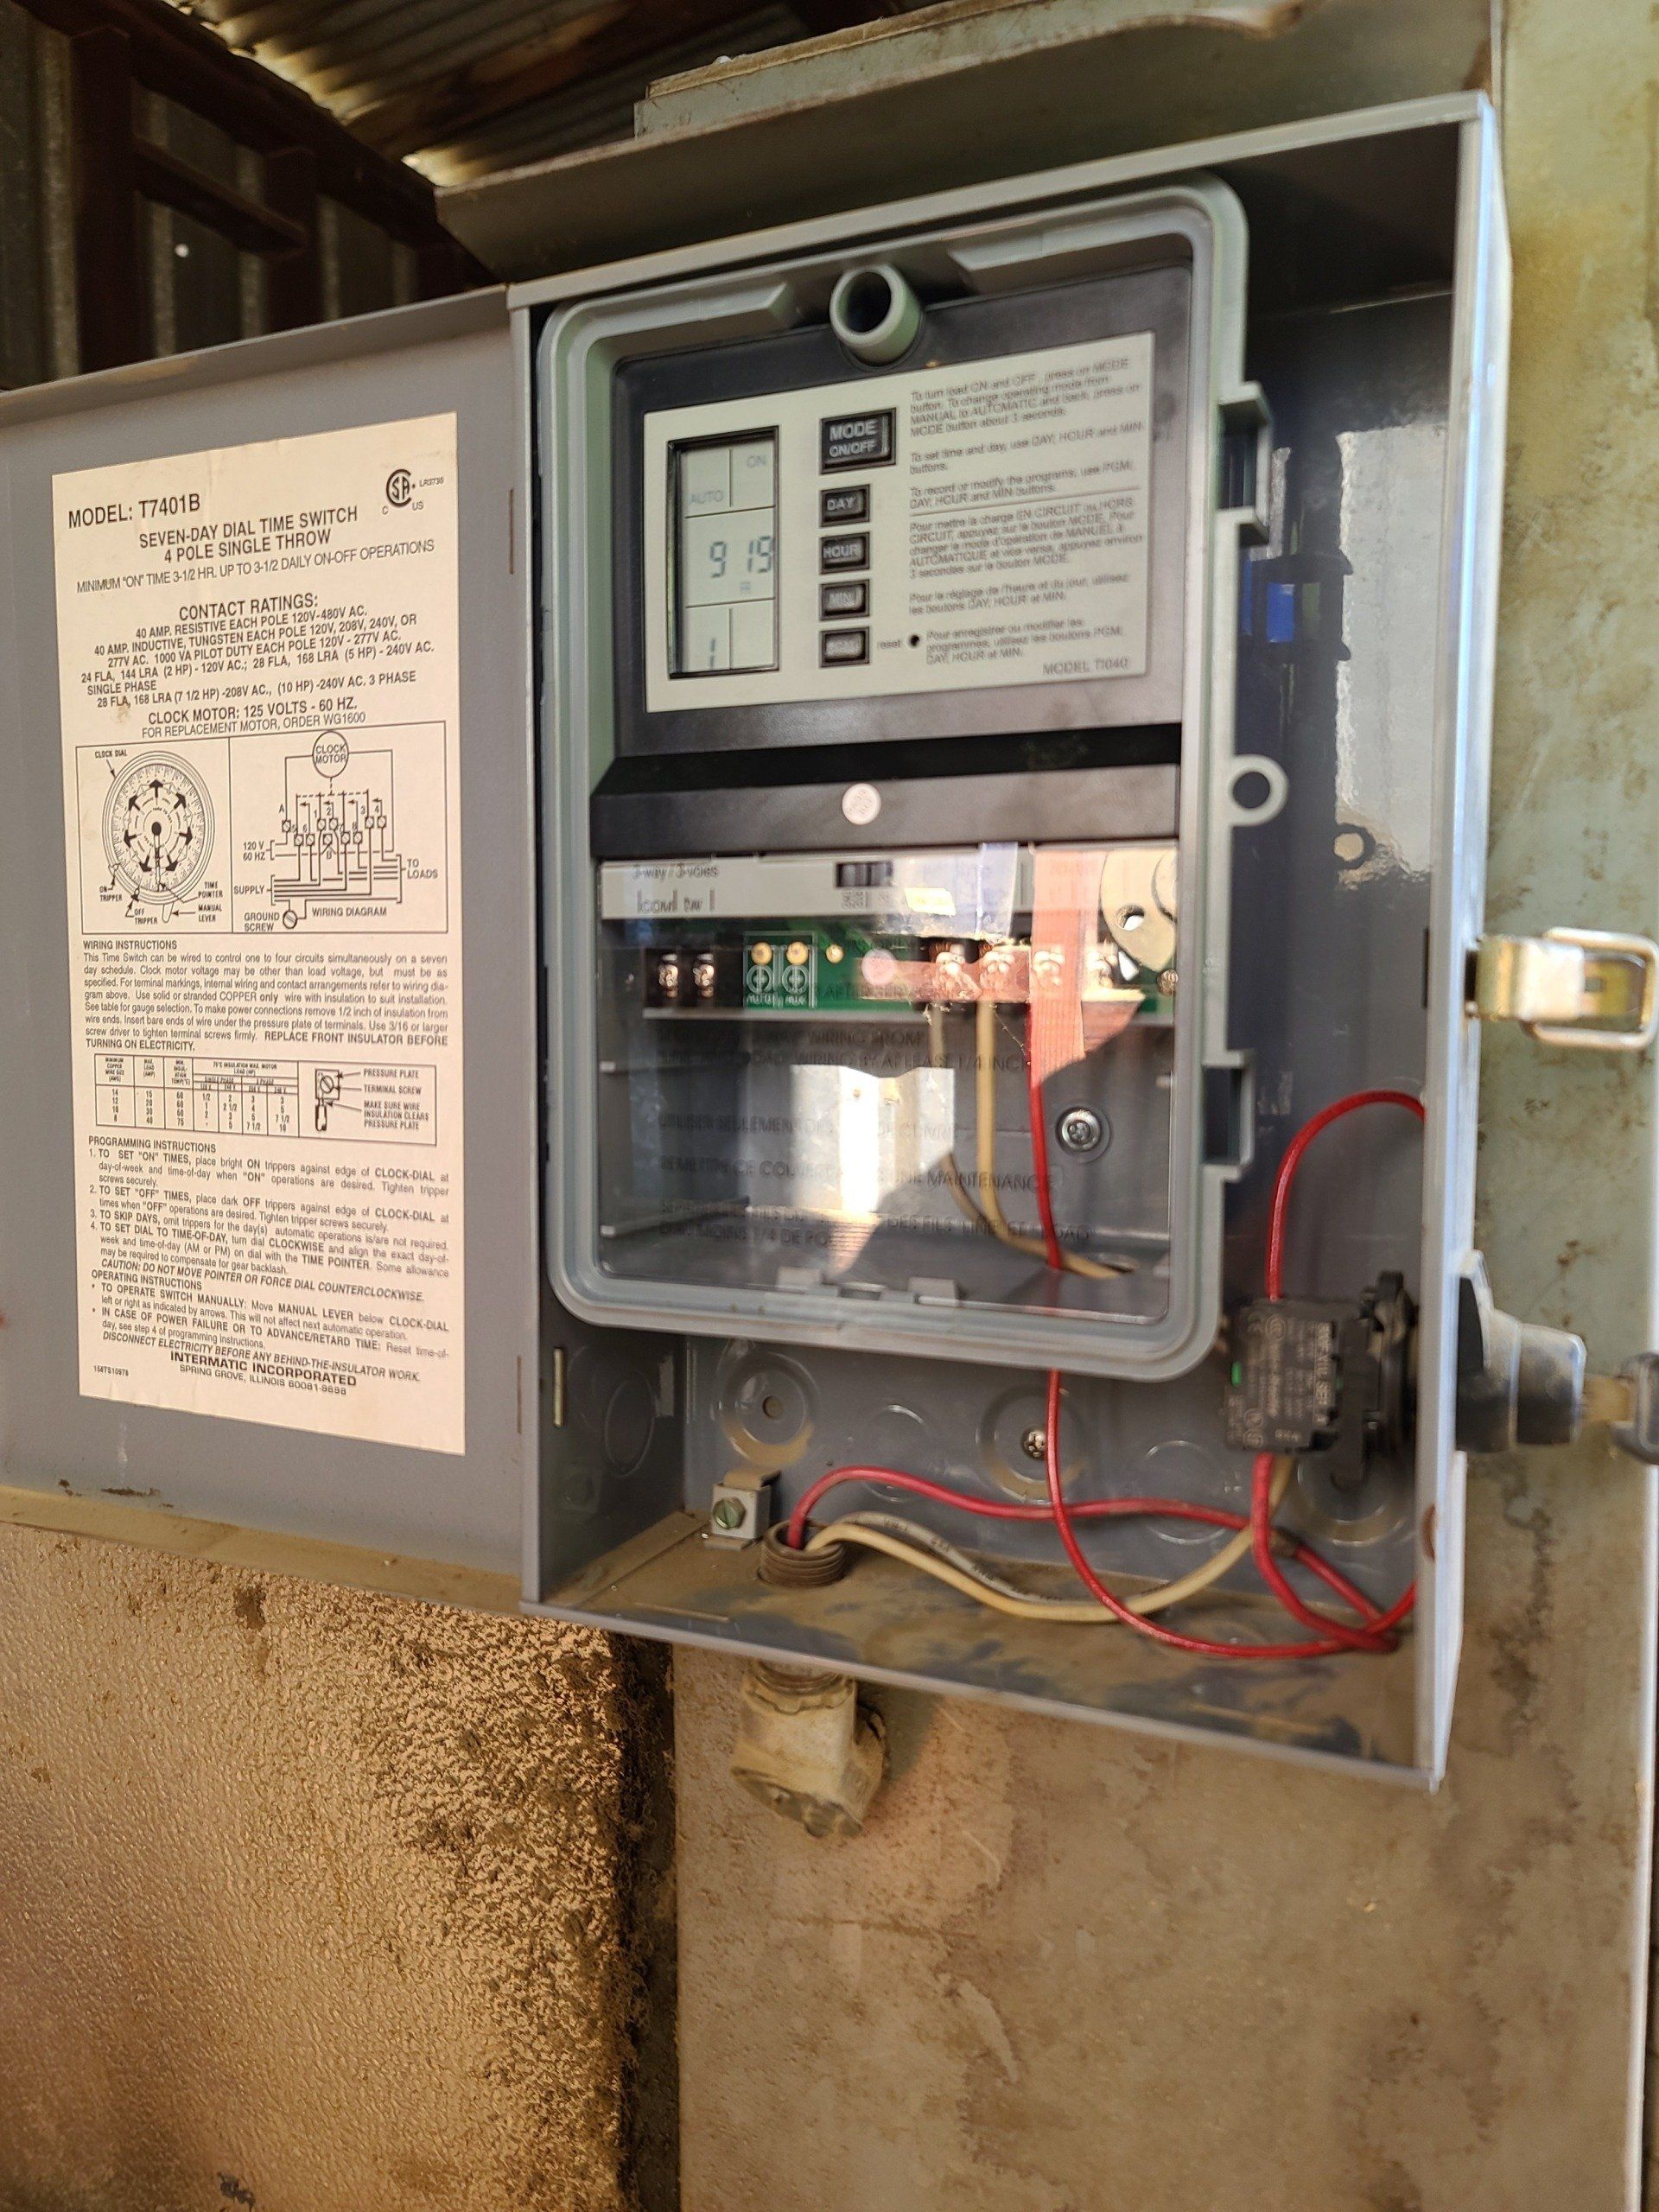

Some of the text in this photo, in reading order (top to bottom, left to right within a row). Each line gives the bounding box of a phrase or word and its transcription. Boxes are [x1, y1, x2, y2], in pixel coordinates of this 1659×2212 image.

[830, 419, 878, 442] MODE
[829, 440, 876, 458] ON/OFF
[68, 493, 200, 527] MODEL: T7401B
[412, 501, 424, 511] US
[827, 496, 855, 511] DAY
[139, 505, 357, 548] SEVEN-DAY DIAL TIME SWITCH
[164, 528, 331, 564] 4 POLE SINGLE THROW
[823, 544, 861, 558] HOUR
[77, 577, 120, 592] MINIMUM
[146, 570, 170, 584] TIME
[173, 568, 195, 582] 3-1/2
[219, 563, 234, 576] UP
[236, 562, 251, 575] TO
[253, 558, 278, 573] 3-1/2
[281, 554, 311, 569] DAILY
[314, 548, 357, 565] ON-OFF
[359, 539, 435, 559] OPERATIONS
[179, 593, 317, 620] CONTACT RATINGS:
[136, 627, 146, 639] 40
[175, 620, 226, 634] RESISTIVE
[229, 616, 257, 629] EACH
[261, 613, 289, 626] POLE
[292, 607, 346, 623] 120V-480V
[94, 645, 105, 655] 40
[188, 632, 243, 646] TUNGSTEN
[246, 628, 275, 641] EACH
[278, 625, 306, 638] POLE
[400, 613, 416, 625] OR
[108, 656, 130, 667] 277V
[154, 652, 175, 663] 1000
[178, 649, 192, 661] VA
[194, 646, 223, 659] PILOT
[226, 644, 253, 657] DUTY
[256, 640, 284, 654] EACH
[289, 637, 316, 651] POLE
[319, 634, 344, 649] 120V
[353, 632, 379, 645] 277V
[81, 672, 91, 683] 24
[120, 668, 136, 679] 144
[139, 666, 158, 678] LRA
[163, 665, 172, 677] (2
[175, 663, 192, 675] HP)
[201, 660, 224, 672] 120V
[252, 657, 264, 669] 28
[296, 652, 314, 664] 168
[317, 649, 339, 662] LRA
[345, 647, 354, 662] (5
[358, 645, 376, 659] HP)
[386, 643, 411, 655] 240V
[87, 679, 156, 695] SINGLE PHASE
[97, 696, 107, 707] 28
[134, 694, 149, 704] 168
[152, 691, 172, 703] LRA
[175, 690, 182, 703] (7
[186, 690, 200, 701] 1/2
[202, 688, 219, 700] HP)
[221, 685, 249, 697] -208V
[277, 681, 292, 695] (10
[296, 679, 314, 692] HP)
[316, 677, 345, 690] -240V
[369, 674, 375, 685] 3
[378, 671, 416, 684] PHASE
[149, 709, 189, 724] CLOCK
[193, 706, 239, 721] MOTOR:
[244, 703, 263, 717] 125
[267, 700, 307, 715] VOLTS
[319, 698, 333, 712] 60
[142, 711, 365, 738] FOR REPLACEMENT MOTOR, ORDER WG1600
[315, 744, 346, 754] CLOCK
[315, 754, 346, 764] MOTOR
[244, 842, 257, 850] 120
[243, 852, 265, 861] 60 HZ
[407, 859, 419, 868] TO
[407, 868, 438, 879] LOADS
[233, 886, 264, 894] SUPPLY
[244, 912, 280, 921] GROUND
[312, 907, 387, 917] WIRING DIAGRAM
[244, 923, 274, 931] SCREW
[83, 939, 177, 950] WIRING INSTRUCTIONS
[86, 1038, 122, 1048] TURNING
[124, 1039, 137, 1049] ON
[264, 1031, 447, 1046] REPLACE FRONT INSULATOR BEFORE
[89, 1135, 216, 1153] PROGRAMMING INSTRUCTIONS
[92, 1269, 201, 1290] OPERATING INSTRUCTIONS
[101, 1282, 245, 1308] TO OPERATE SWITCH MANUALLY:
[171, 1351, 356, 1385] INTERMATIC INCORPORATED
